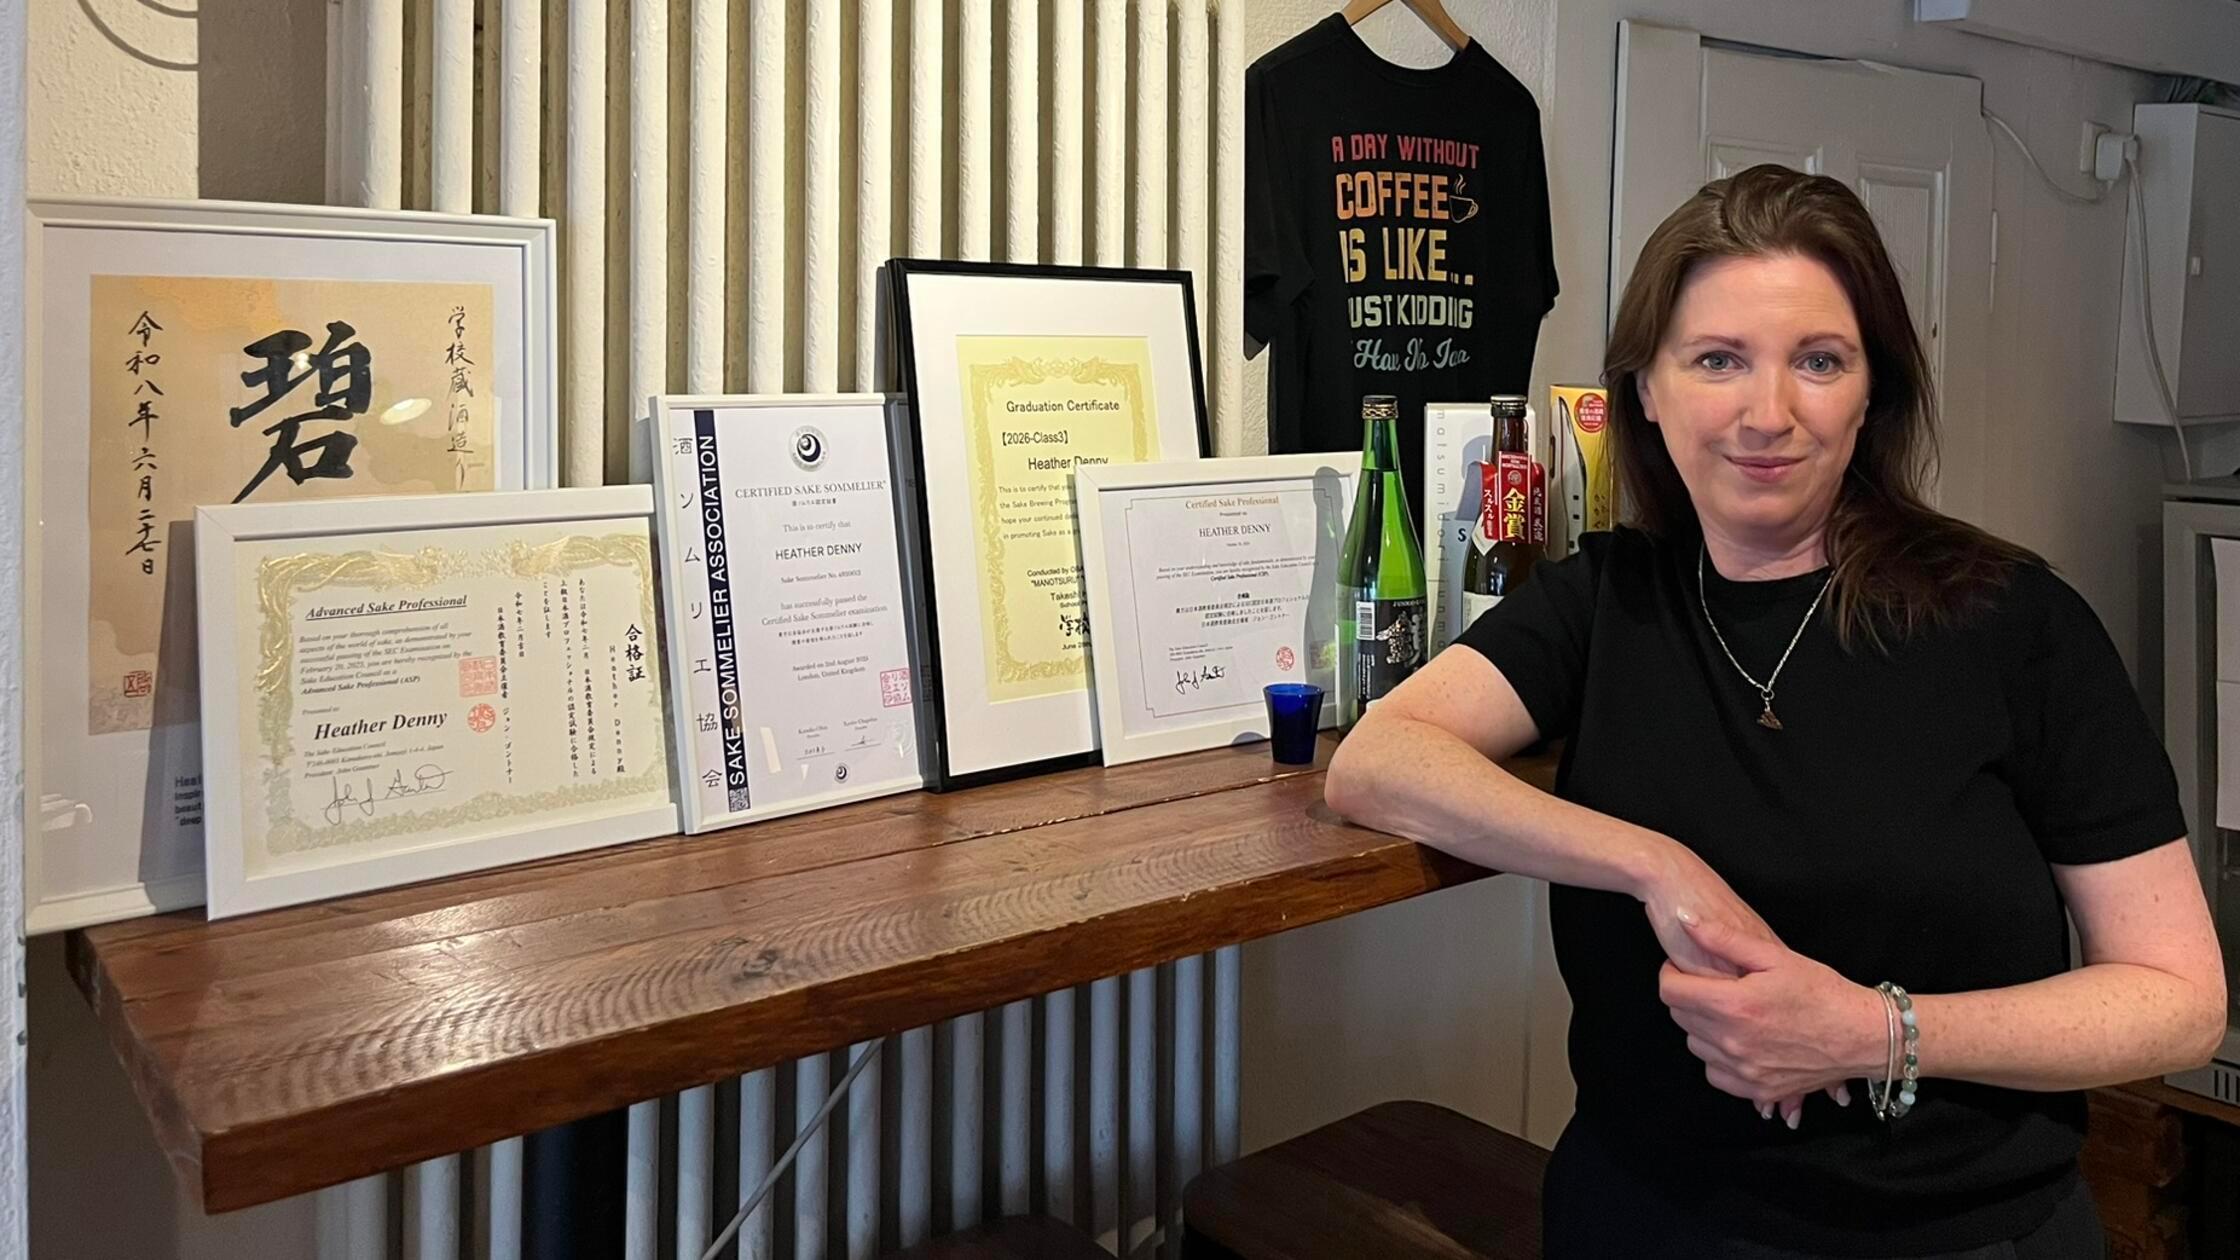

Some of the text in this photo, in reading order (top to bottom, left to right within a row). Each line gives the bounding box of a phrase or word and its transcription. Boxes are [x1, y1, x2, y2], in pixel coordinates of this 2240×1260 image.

[1331, 134, 1480, 170] A DAY WITHOUT
[1336, 171, 1449, 220] COFFEE
[1339, 227, 1367, 283] IS
[1348, 295, 1392, 328] UST
[230, 320, 372, 501] 碧
[1006, 399, 1120, 413] Graduation Certificate
[125, 311, 163, 575] 令和八年六月二十七日
[1002, 431, 1069, 446] 【2026-Class3】
[1028, 456, 1071, 470] Heather
[735, 485, 793, 499] CERTIFIED
[794, 484, 822, 495] SAKE
[1028, 484, 1046, 492] certify
[1030, 499, 1053, 507] Brewing
[1185, 495, 1279, 510] Certified Sake Professional
[1034, 513, 1062, 521] continued
[1502, 487, 1528, 540] 金賞
[783, 524, 799, 533] This
[815, 520, 836, 532] certify
[837, 520, 851, 528] that
[1199, 523, 1271, 537] HEATHER DENNY
[1011, 531, 1041, 540] promoting
[1042, 529, 1057, 537] Sake
[1457, 527, 1468, 543] S
[775, 543, 863, 560] HEATHER DENNY
[1027, 567, 1060, 577] Conducted
[1061, 567, 1069, 575] by
[306, 595, 467, 618] Advanced Sake Professional
[794, 597, 833, 609] successfully
[835, 594, 856, 606] passed
[857, 593, 868, 601] the
[699, 435, 746, 785] SAKE SOMMELIER ASSOCIATION
[761, 615, 791, 625] Certified
[793, 613, 809, 622] Sake
[811, 610, 847, 620] Sommelier
[332, 633, 348, 641] your
[350, 629, 380, 638] thorough
[381, 625, 430, 635] comprehension
[348, 640, 368, 648] world
[400, 644, 440, 653] Examination
[625, 624, 646, 682] 合格証
[300, 666, 332, 675] February
[301, 677, 317, 685] Sake
[319, 673, 353, 682] Education
[356, 670, 382, 679] Council
[609, 645, 619, 708] Heather
[300, 684, 336, 695] Advanced
[356, 678, 399, 688] Professional
[400, 676, 421, 684] (ASP)
[314, 719, 387, 740] Heather
[392, 713, 447, 730] Denny
